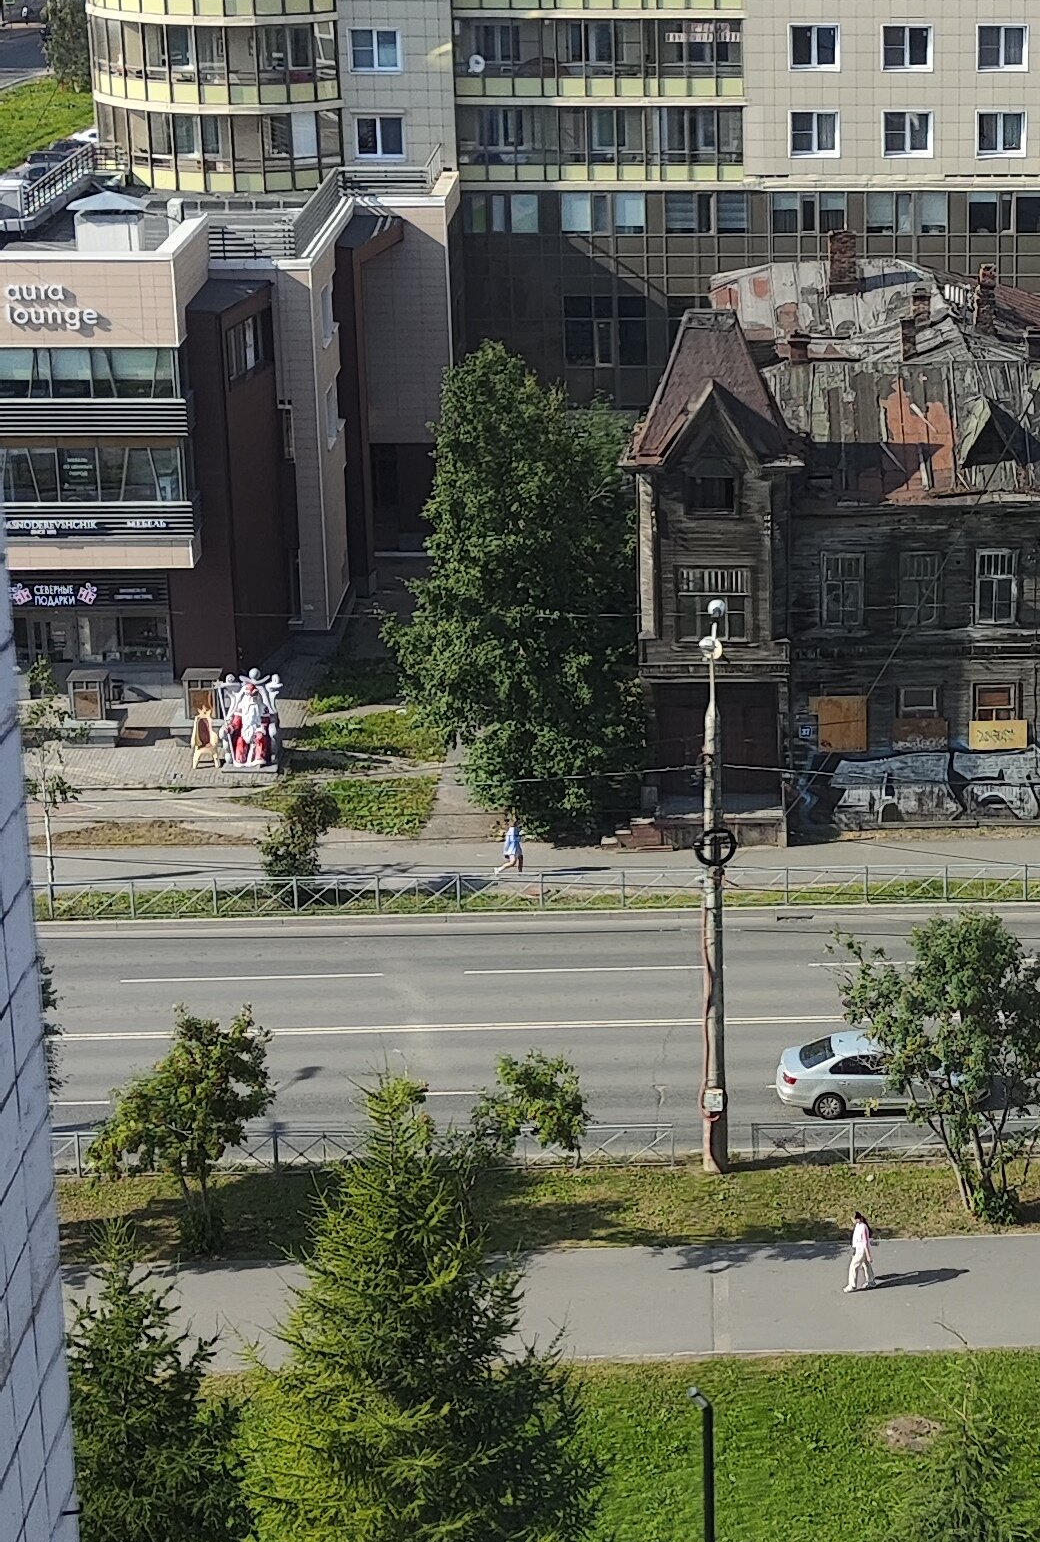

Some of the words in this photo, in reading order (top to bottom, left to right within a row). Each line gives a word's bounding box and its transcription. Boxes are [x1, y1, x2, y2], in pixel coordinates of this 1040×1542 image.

[6, 284, 65, 301] aura
[6, 303, 99, 330] lounge
[33, 584, 74, 595] СЕВЕРНЫЕ
[34, 595, 76, 606] ПОДАРКИ
